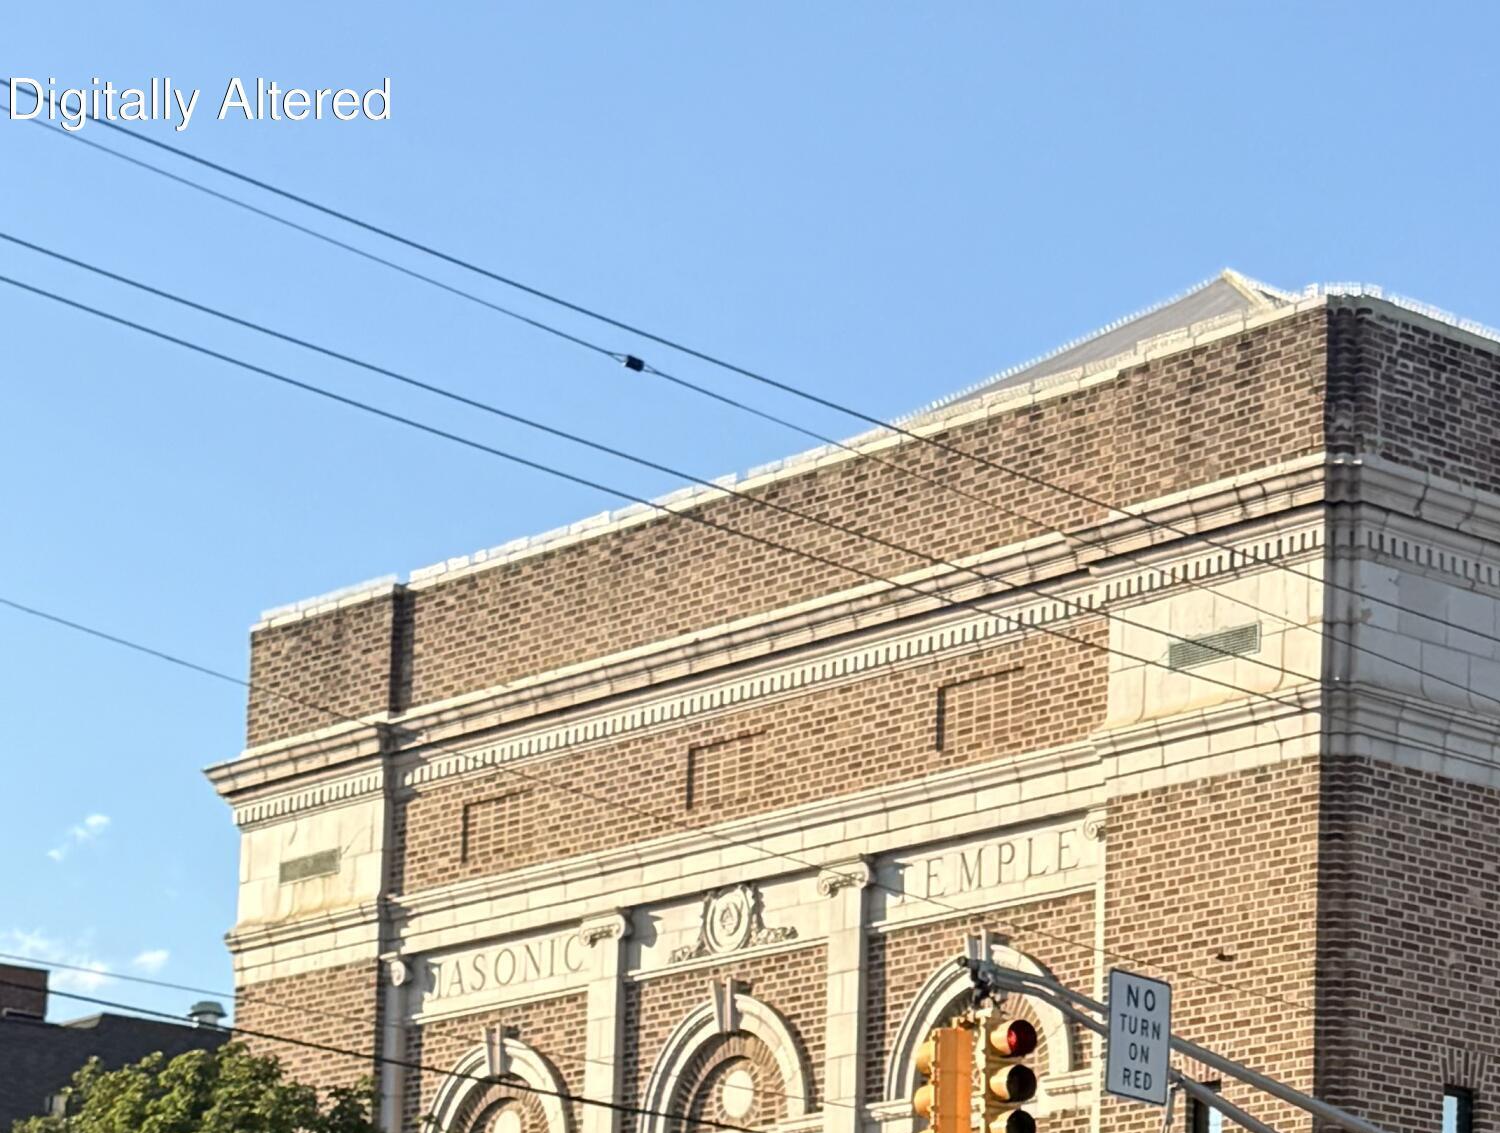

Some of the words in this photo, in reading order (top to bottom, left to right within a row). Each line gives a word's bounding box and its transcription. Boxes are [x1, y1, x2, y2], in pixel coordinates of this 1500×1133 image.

[892, 828, 1080, 904] TEMPLE
[1126, 983, 1156, 1012] NO
[1119, 1012, 1162, 1040] TURN
[1128, 1042, 1150, 1064] ON
[1122, 1067, 1153, 1091] RED
